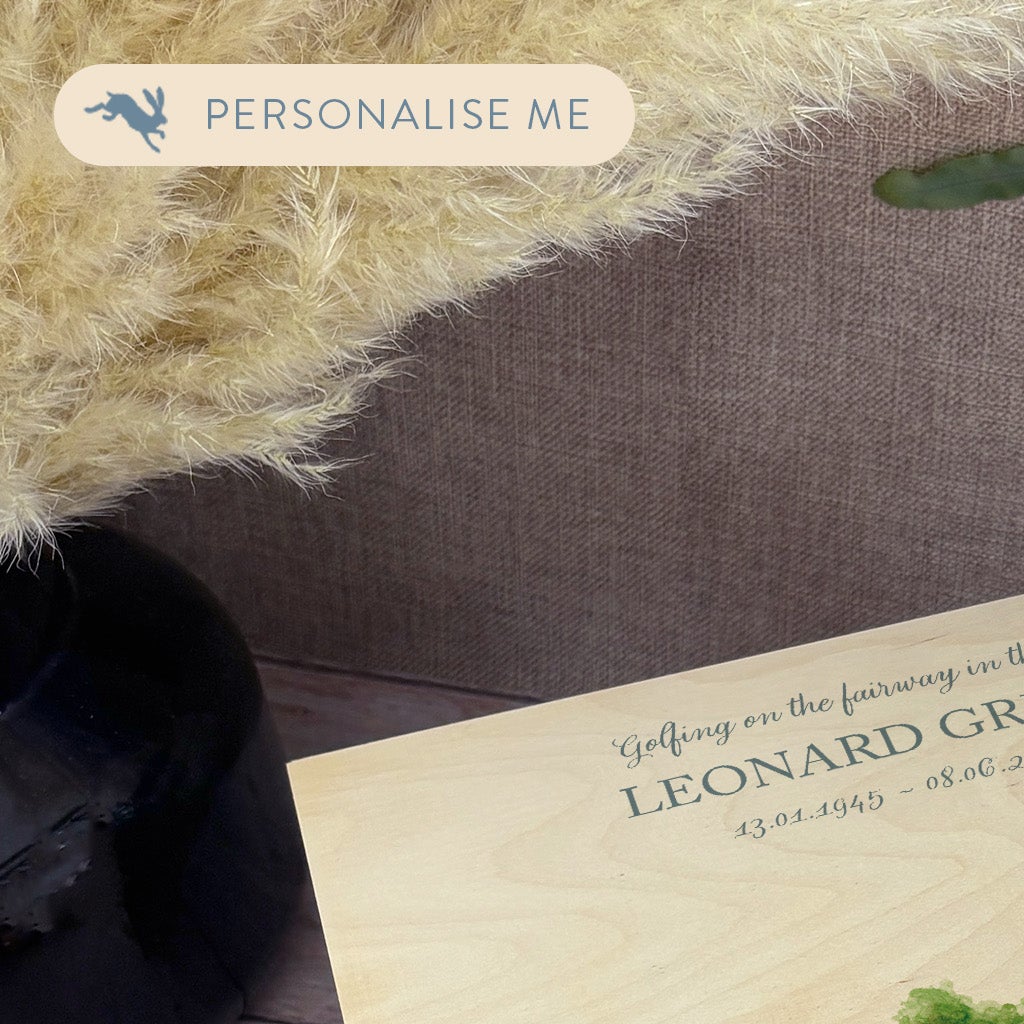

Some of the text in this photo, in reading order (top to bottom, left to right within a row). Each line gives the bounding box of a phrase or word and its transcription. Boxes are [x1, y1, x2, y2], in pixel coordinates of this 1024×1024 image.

[612, 720, 736, 769] Golfing
[743, 709, 784, 730] on
[786, 692, 835, 719] the
[838, 665, 961, 717] fairway
[966, 657, 1003, 678] in
[619, 723, 923, 819] LEONARD
[734, 788, 886, 840] 13.01.1945
